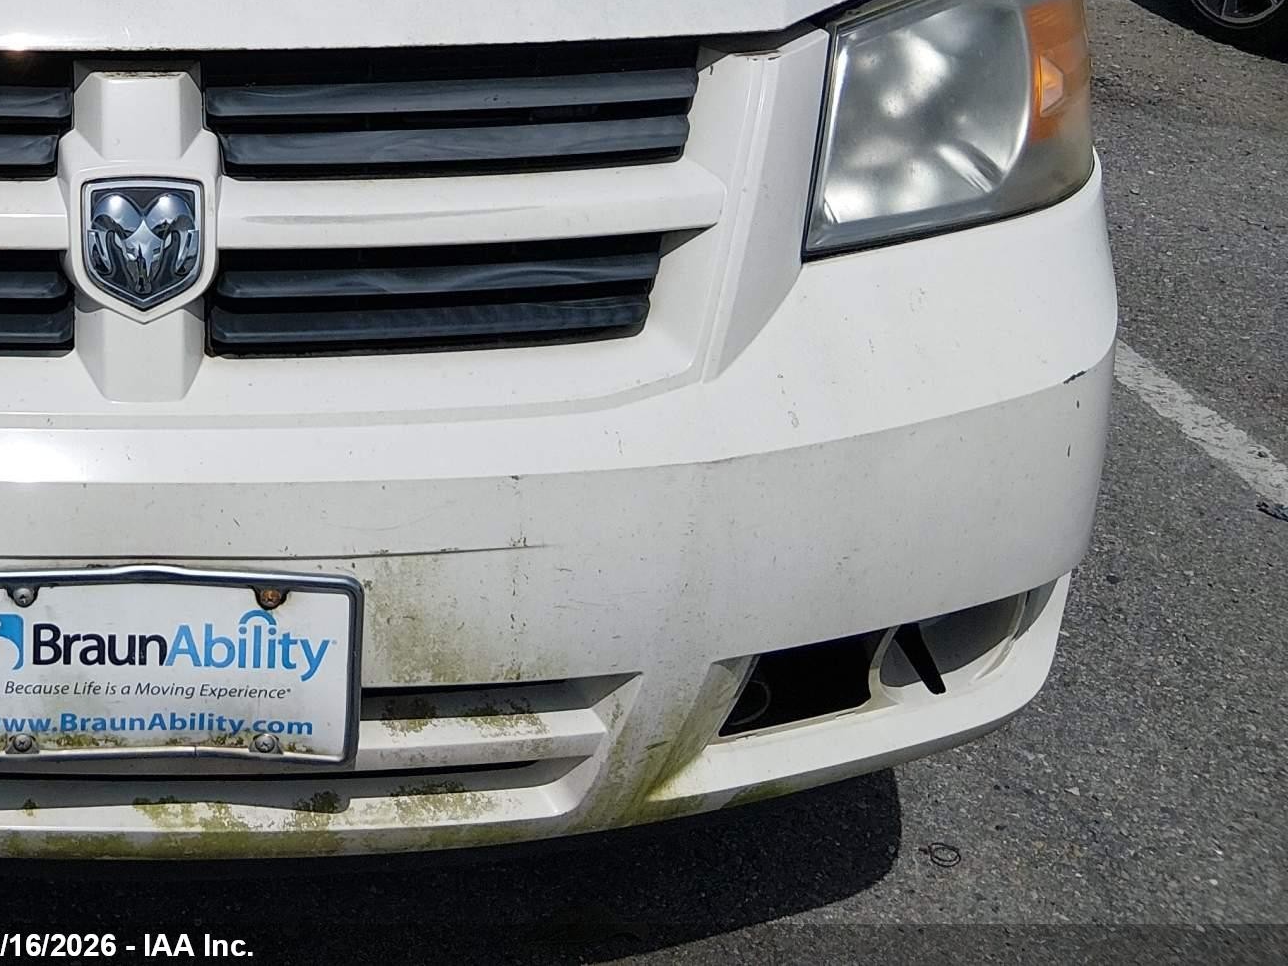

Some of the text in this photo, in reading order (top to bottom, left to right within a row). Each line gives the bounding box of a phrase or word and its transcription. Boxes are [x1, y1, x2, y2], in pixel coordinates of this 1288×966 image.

[31, 614, 330, 682] BraunAbility
[4, 680, 70, 696] Because
[73, 680, 102, 696] Life
[104, 681, 117, 696] is
[120, 684, 131, 696] a
[134, 682, 195, 700] Moving
